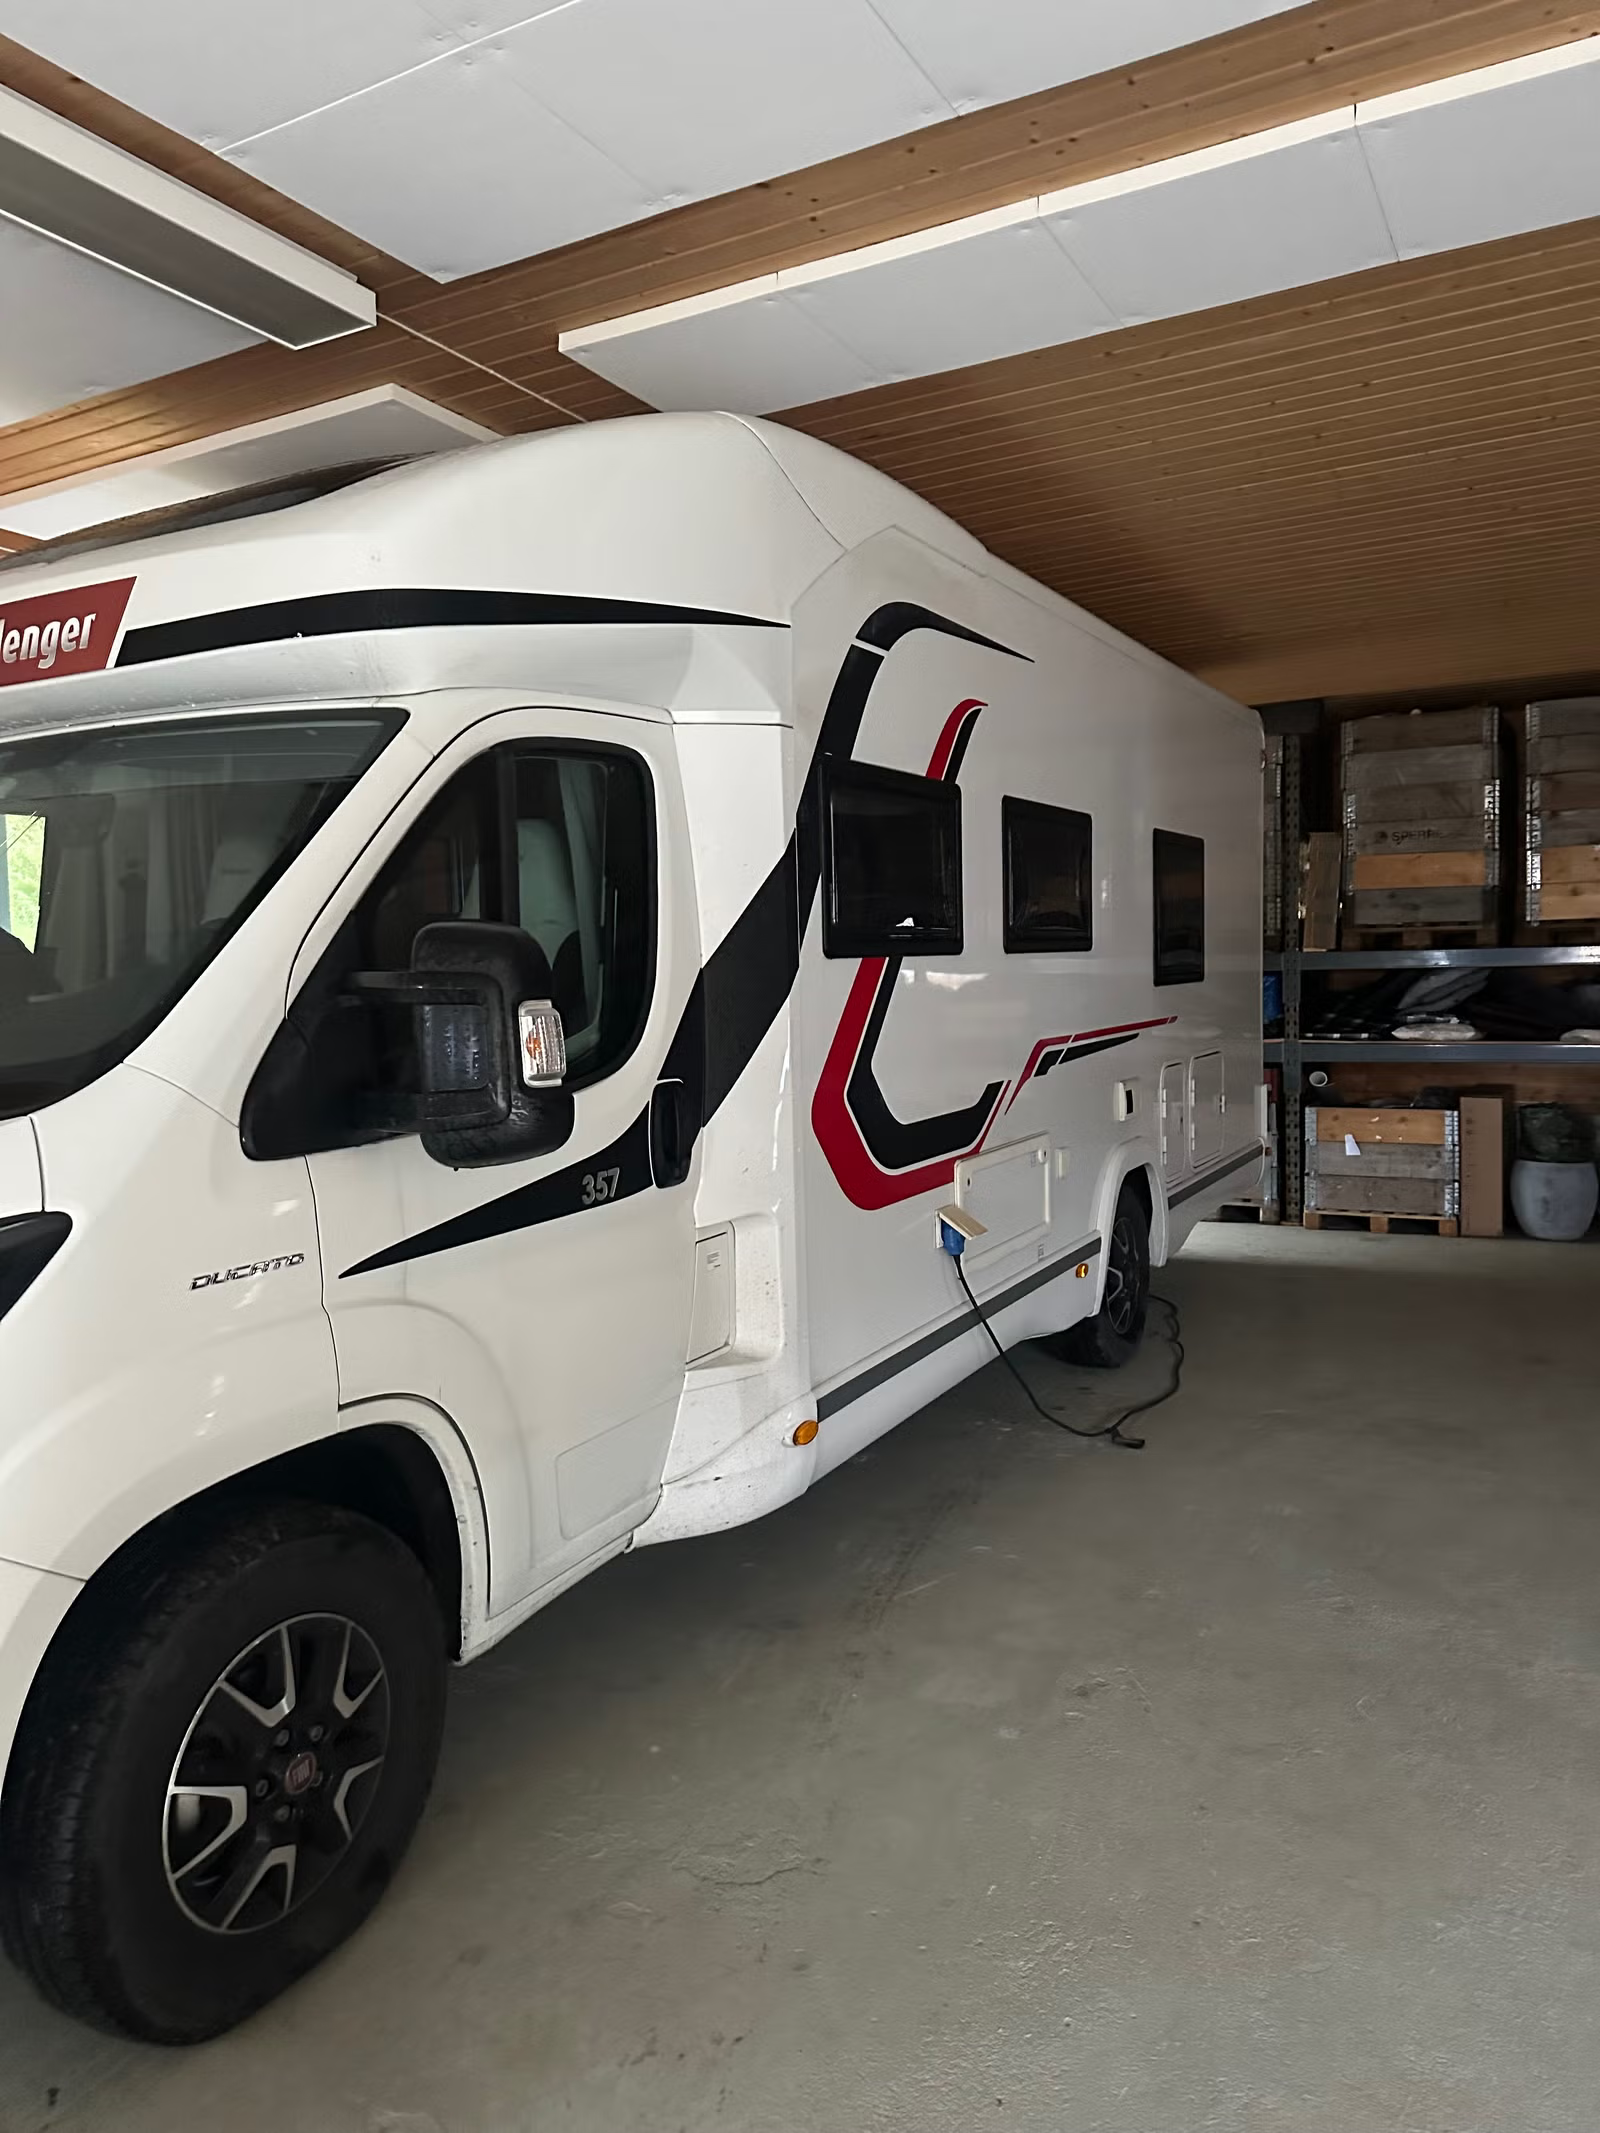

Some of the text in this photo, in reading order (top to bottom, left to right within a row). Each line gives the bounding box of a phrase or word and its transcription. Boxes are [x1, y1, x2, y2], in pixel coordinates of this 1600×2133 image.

[581, 1166, 621, 1206] 357
[189, 1253, 305, 1291] DUCATO
[289, 1759, 311, 1787] FIAT
